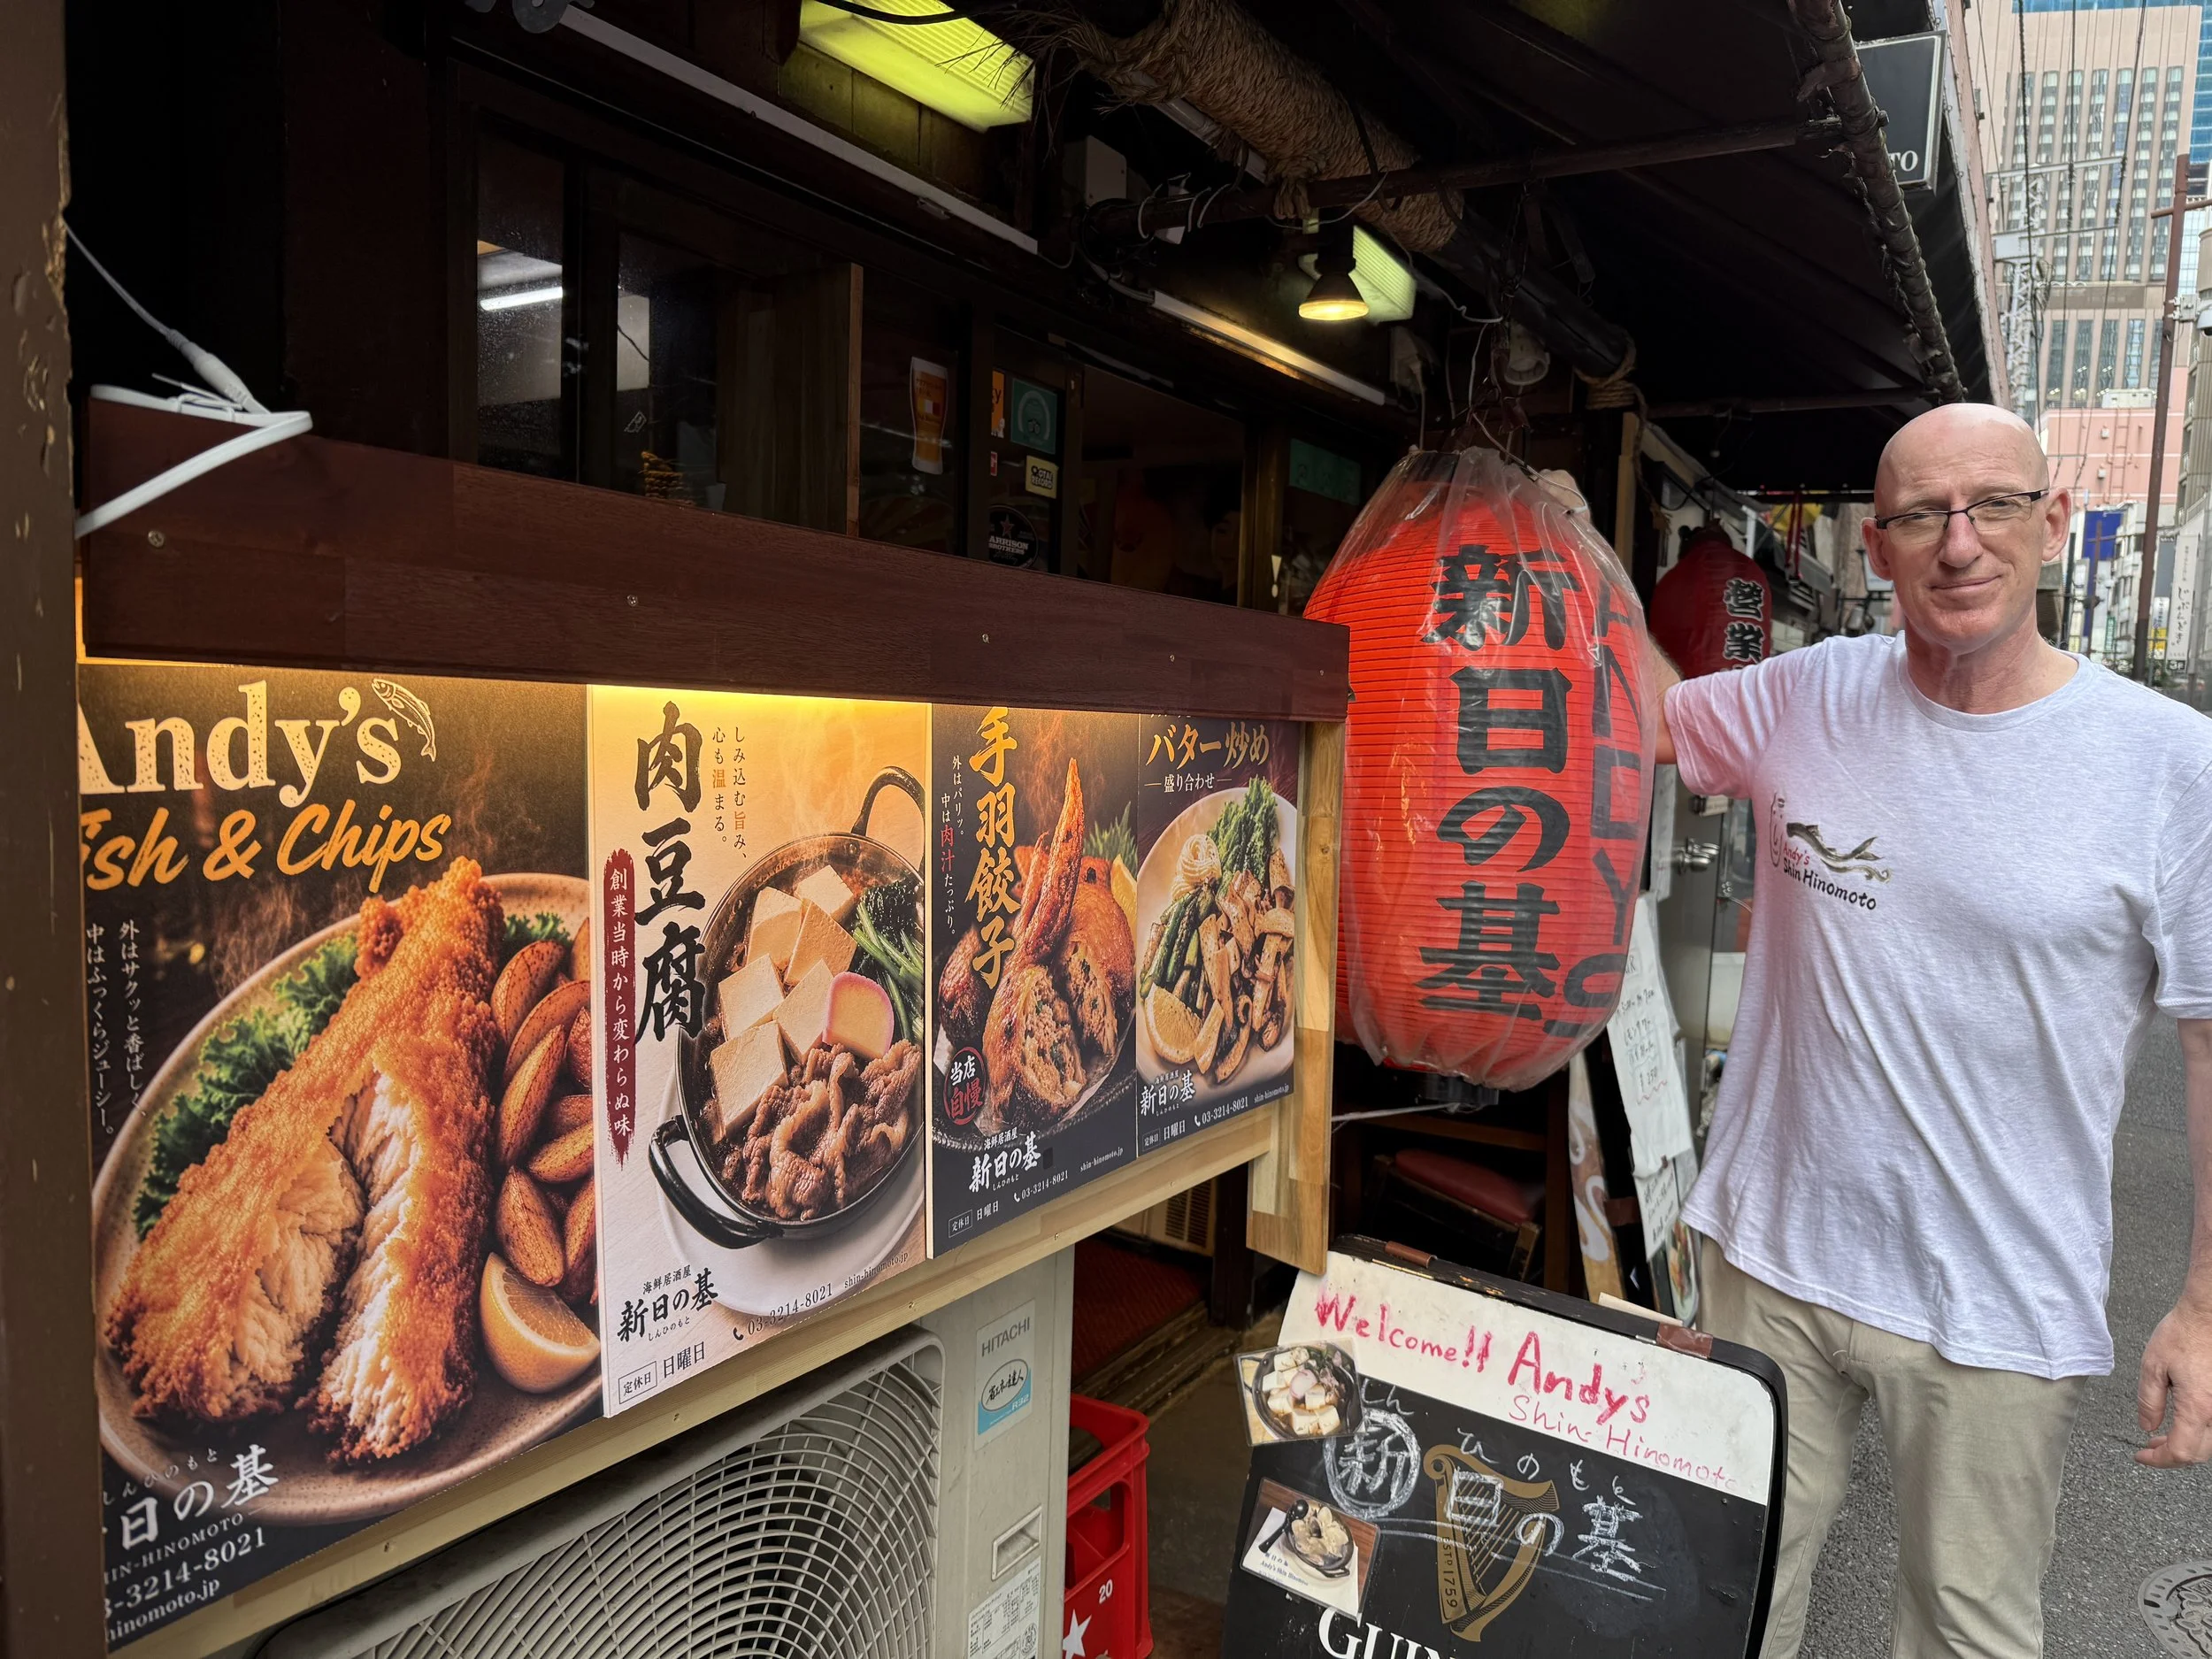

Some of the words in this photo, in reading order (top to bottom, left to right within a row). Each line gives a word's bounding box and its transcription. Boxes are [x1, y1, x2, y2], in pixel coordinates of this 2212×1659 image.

[988, 535, 1029, 550] ARRISON
[1146, 721, 1270, 770] バター炒め
[712, 727, 727, 843] 心も温まる。
[733, 726, 748, 859] しみ込む旨み、
[952, 756, 965, 835] 外はパリッ。
[1164, 772, 1215, 793] 盛り合わせ
[1415, 544, 1584, 1021] 新日の基
[203, 810, 262, 881] &
[276, 799, 452, 893] Chips
[941, 793, 956, 934] 中は肉汁たっぷり。
[964, 706, 1023, 990] 手羽餃子
[1783, 842, 1810, 865] Andy's
[634, 701, 706, 1046] 肉豆腐
[1784, 858, 1801, 882] Shin
[1803, 868, 1877, 910] Hinomoto
[610, 868, 633, 1136] 創業当時から変わらぬ味
[86, 923, 114, 1134] 中はふっくらジューシー。
[950, 1055, 976, 1087] 当店
[1141, 1070, 1195, 1117] 新日の基
[951, 1079, 984, 1118] 自慢
[1164, 1119, 1186, 1141] 日曜日
[1202, 1096, 1248, 1125] 03-3214-8021
[969, 1131, 1041, 1192] 新日の基
[977, 1201, 1000, 1221] 日曜日
[1021, 1170, 1069, 1200] 03-3214-8021
[617, 1267, 718, 1342] 新日の基
[643, 1264, 692, 1295] 海鮮居酒屋
[623, 1371, 652, 1396] 定休日
[663, 1341, 705, 1379] 日曜日
[748, 1283, 833, 1335] 03-3214-8021
[844, 1251, 909, 1289] shin-hinomoto.jp
[649, 1317, 691, 1341] しんひのもと
[981, 1316, 1031, 1357] HITACHI
[1012, 1394, 1029, 1411] R32
[101, 1443, 280, 1550] 日の基
[1098, 1579, 1114, 1605] 20
[1443, 1571, 1458, 1609] 1759
